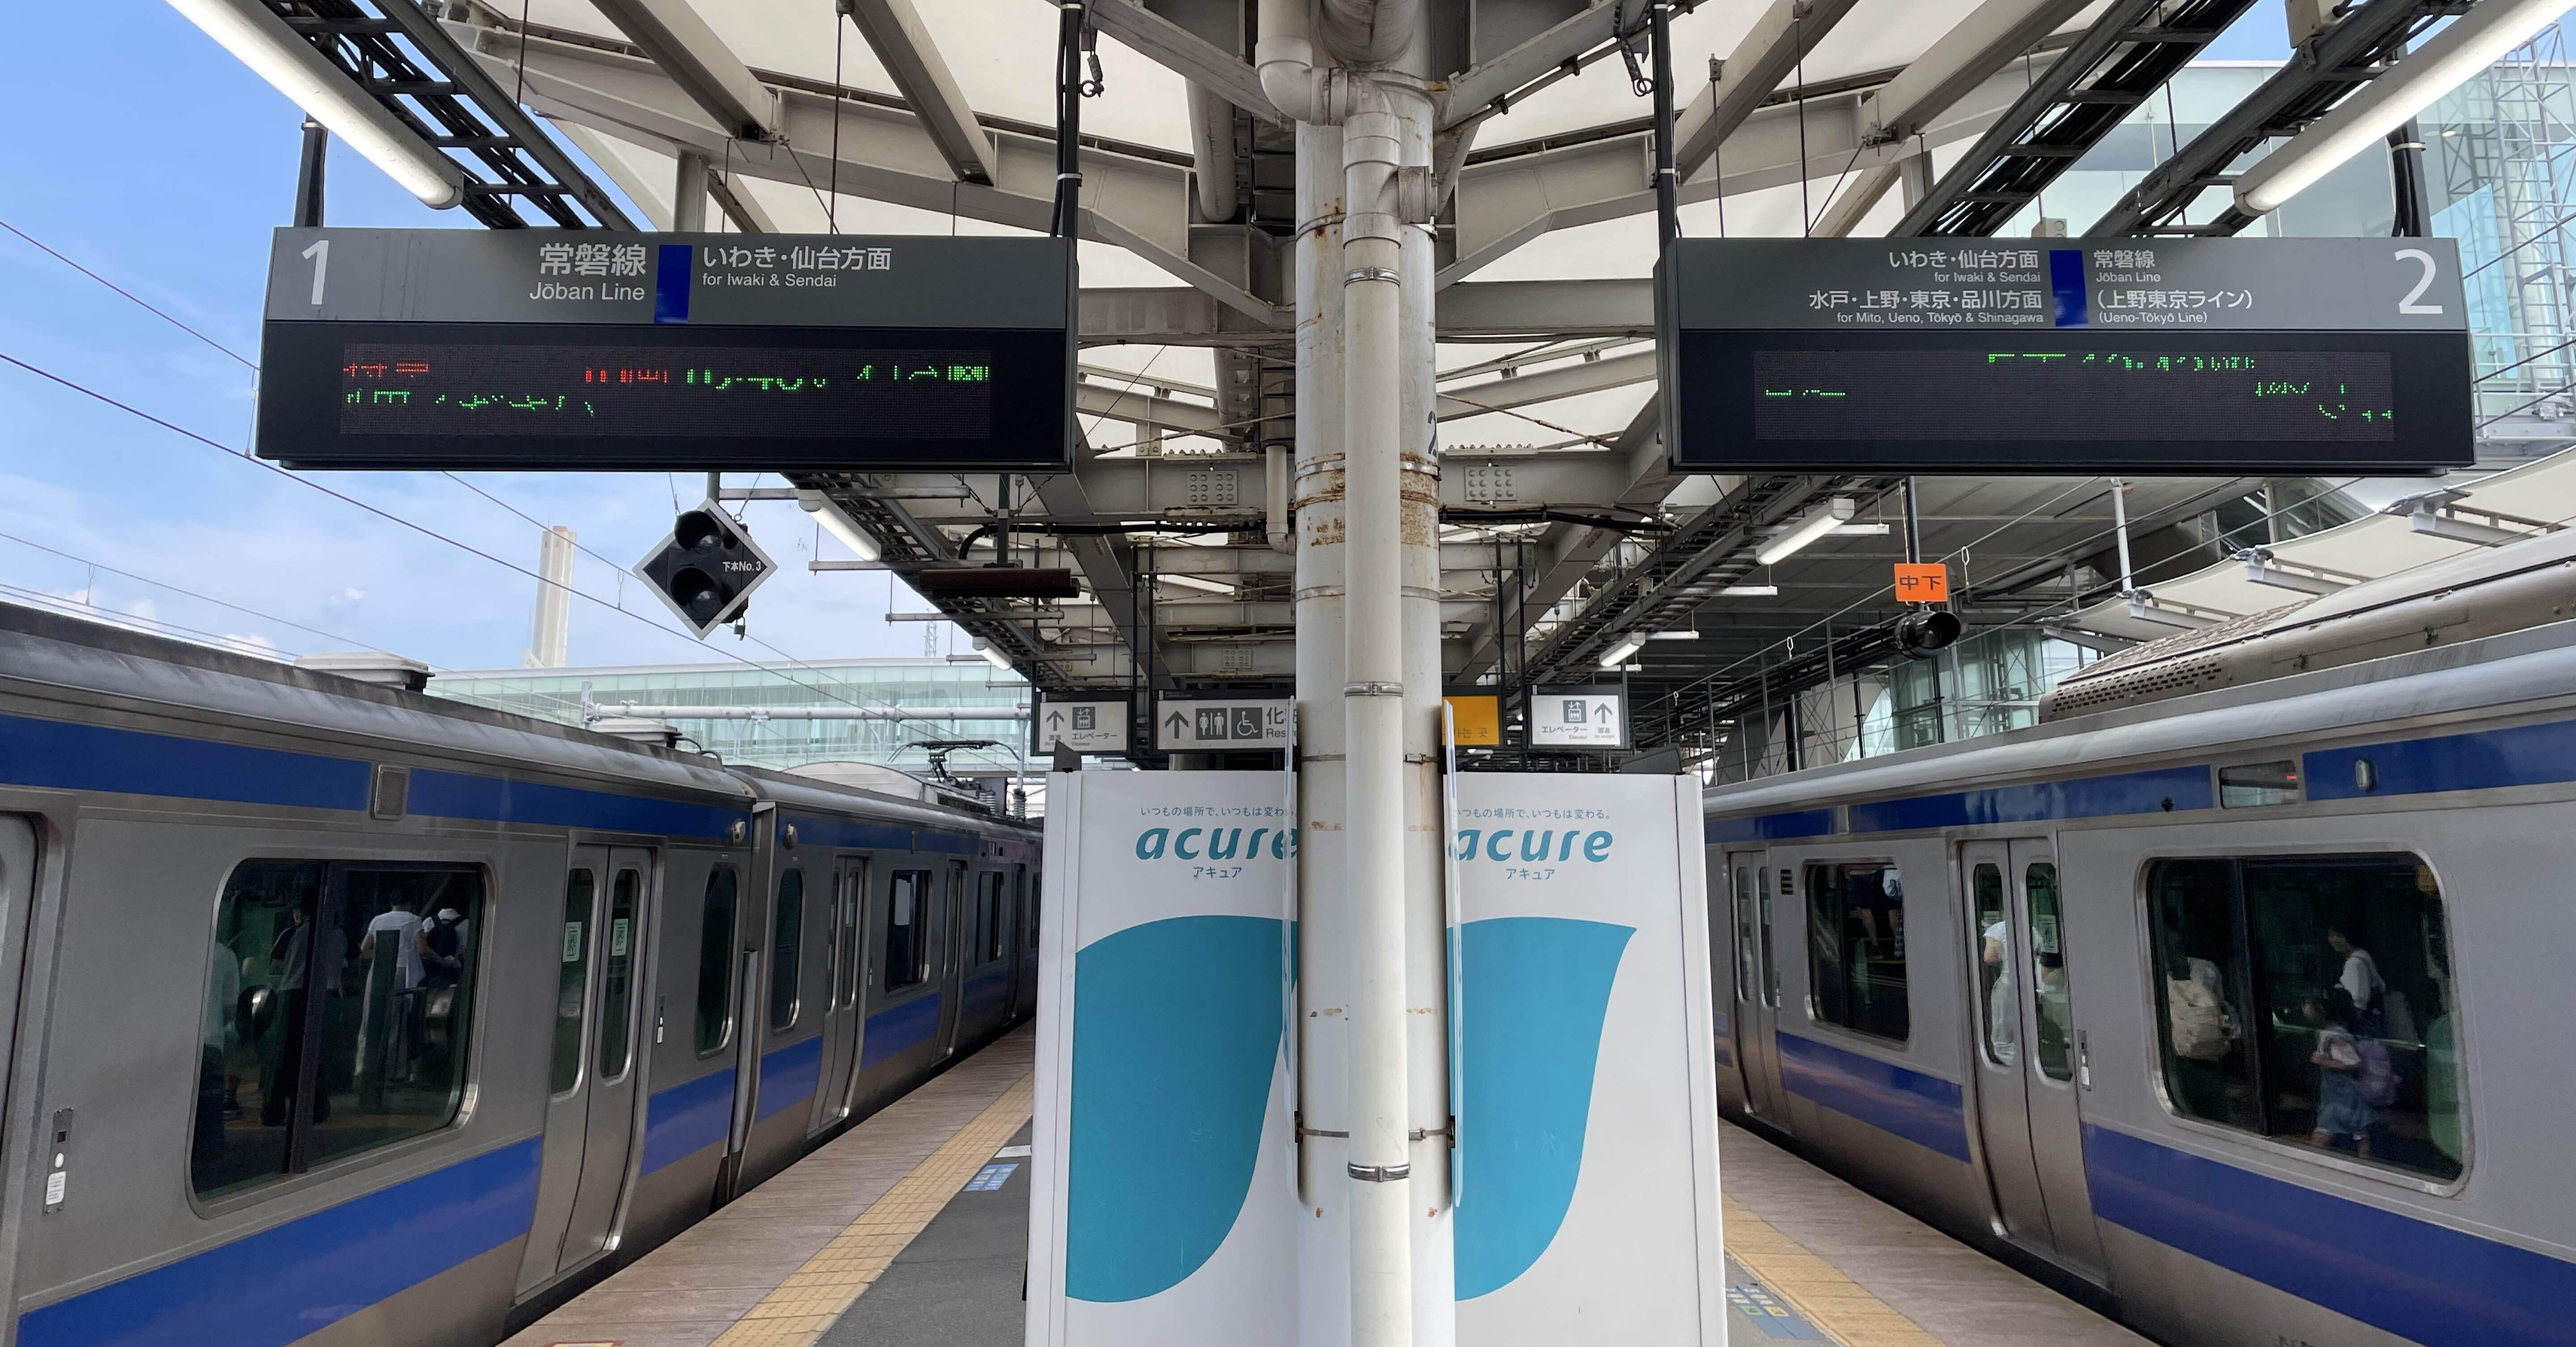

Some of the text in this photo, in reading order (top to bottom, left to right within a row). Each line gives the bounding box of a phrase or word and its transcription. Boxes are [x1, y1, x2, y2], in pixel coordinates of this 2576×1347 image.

[540, 243, 646, 276] 常磐線
[703, 246, 892, 271] いわき・仙台方面
[1889, 250, 2039, 269] いわき・仙台方面
[2093, 250, 2156, 269] 常磐線
[301, 240, 329, 305] 1
[702, 273, 836, 287] for Iwaki & Sendai
[1934, 272, 2041, 283] for Iwaki & Sendai
[2096, 271, 2161, 282] Jōban Line
[2394, 249, 2443, 314] 2
[529, 282, 645, 301] Jōban Line
[1809, 289, 2042, 309] 水戸・上野・東京・品川方面
[2097, 289, 2252, 309] （上野東京ライン）
[1837, 312, 1853, 323] for
[1856, 312, 1885, 325] Mito,
[1888, 312, 1924, 325] Ueno,
[1966, 312, 1974, 323] &
[1978, 312, 2044, 326] Shinagawa
[2178, 311, 2207, 325] Line)
[1899, 575, 1942, 591] 中下
[1135, 827, 1298, 860] acure
[1448, 829, 1614, 862] acure
[1192, 866, 1242, 878] アキュア
[1506, 868, 1555, 880] アキュア
